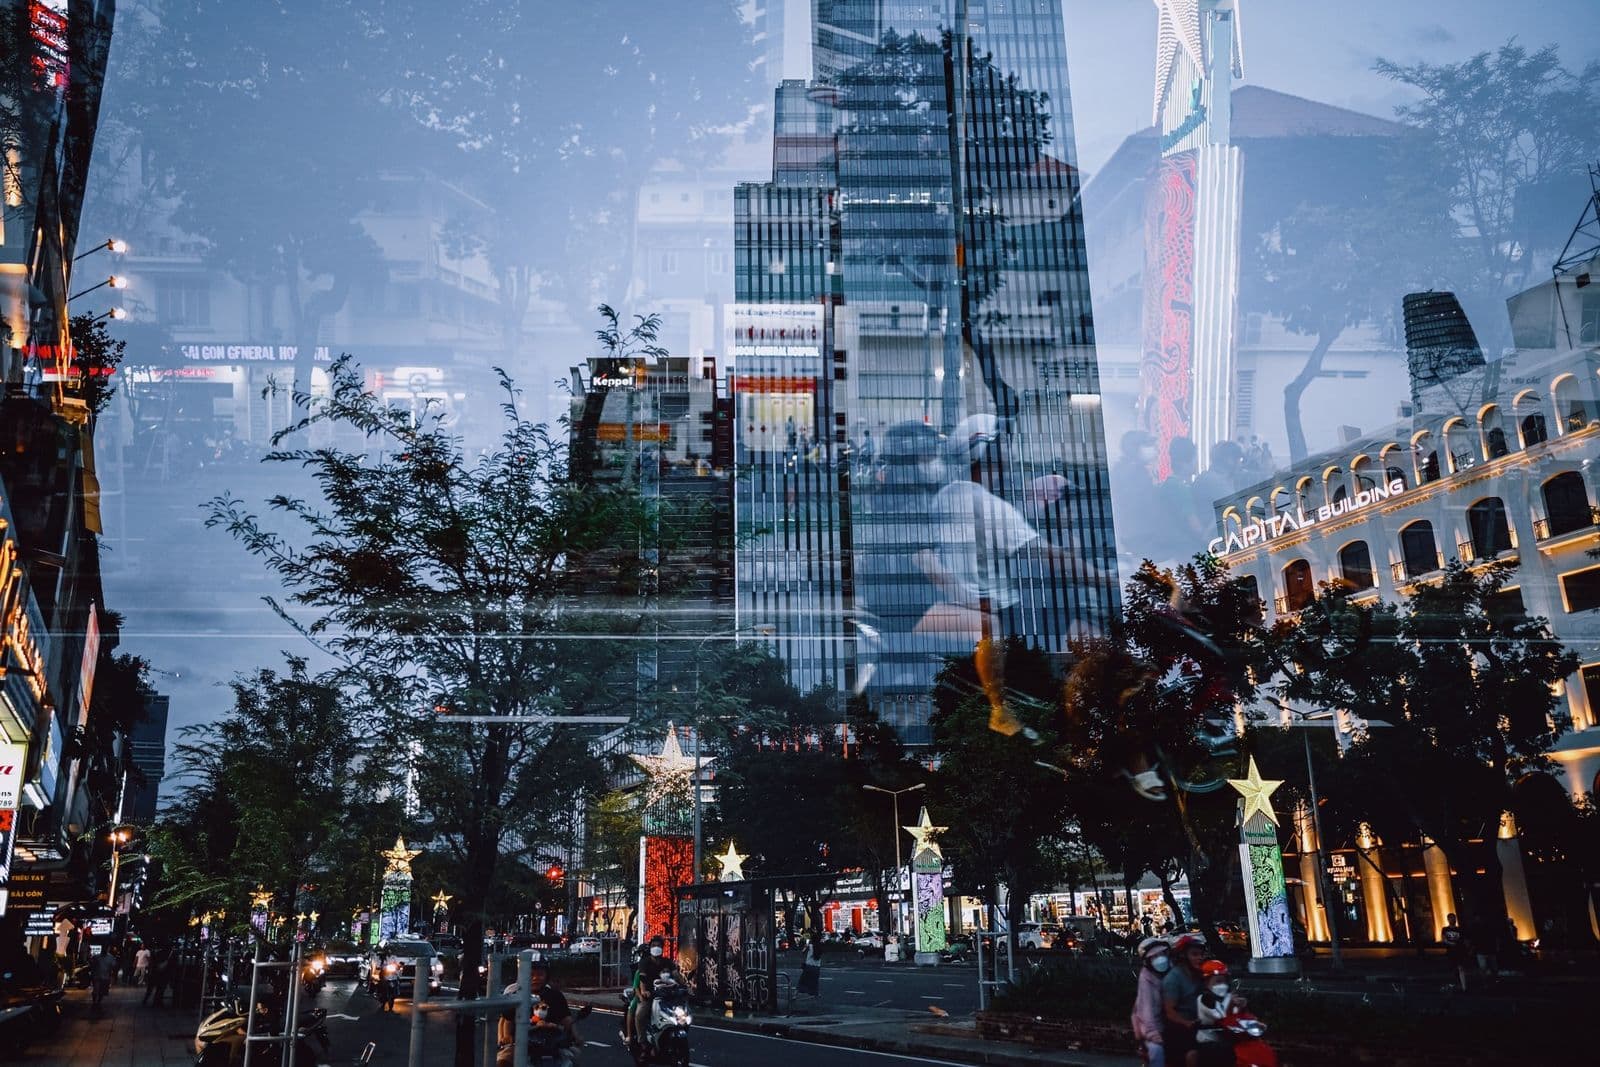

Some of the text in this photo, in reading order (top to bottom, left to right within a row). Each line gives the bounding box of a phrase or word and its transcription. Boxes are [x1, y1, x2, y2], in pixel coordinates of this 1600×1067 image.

[202, 346, 225, 359] GON
[227, 346, 275, 360] GENERAL
[279, 346, 331, 361] HOTAL
[593, 375, 633, 387] Keppel
[1207, 478, 1404, 558] CAPITAL BUILDING
